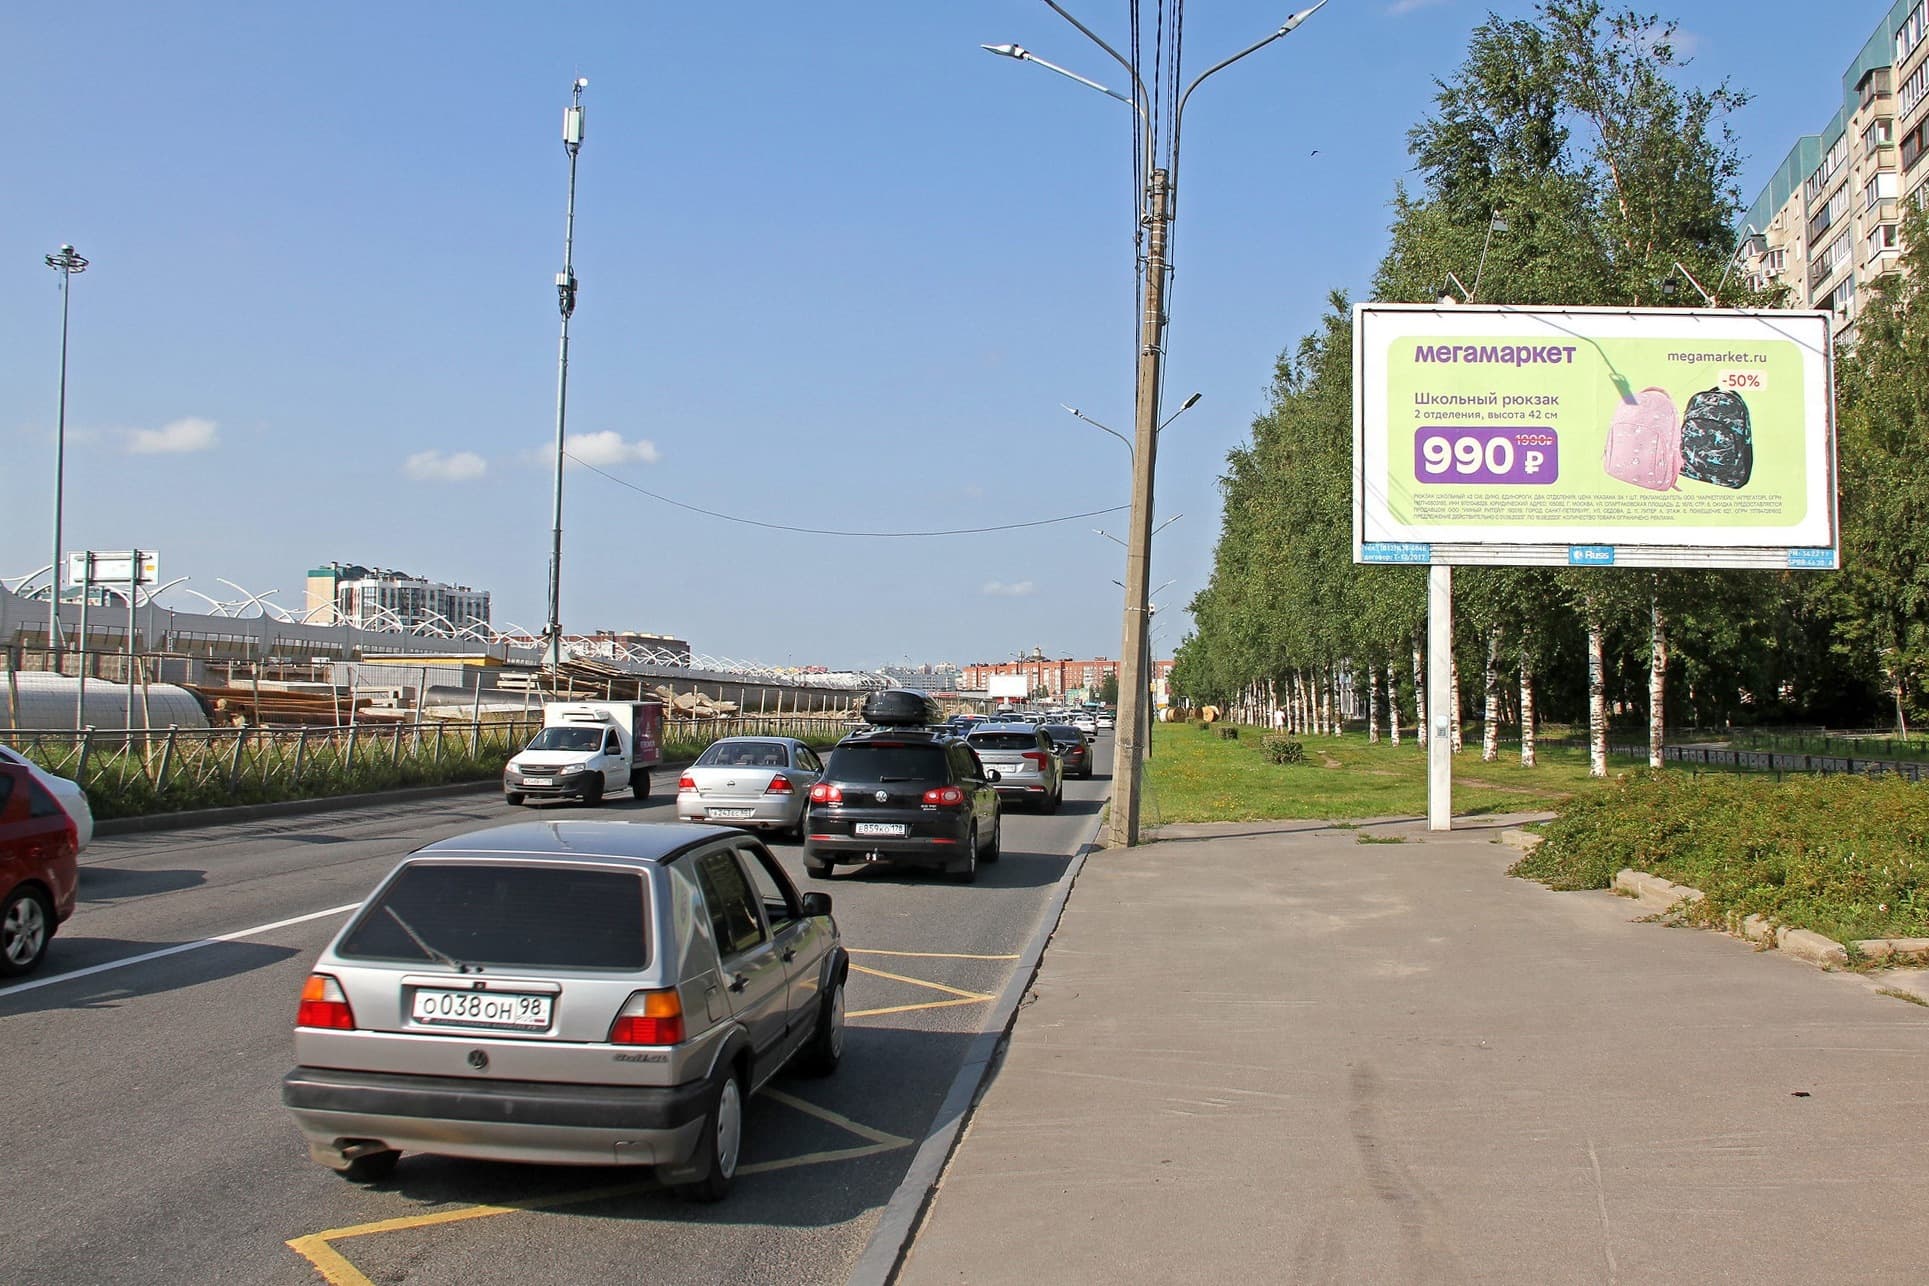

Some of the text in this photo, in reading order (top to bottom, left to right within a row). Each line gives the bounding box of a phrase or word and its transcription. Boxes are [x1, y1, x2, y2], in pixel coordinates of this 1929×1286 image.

[1414, 345, 1577, 367] мегамаркет
[1667, 351, 1767, 364] megamarket.ru
[1722, 374, 1760, 388] -50%
[1414, 392, 1559, 408] Школьный рюкзак
[1414, 410, 1558, 420] 2 отделения, высота 42 см
[1422, 436, 1515, 475] 990
